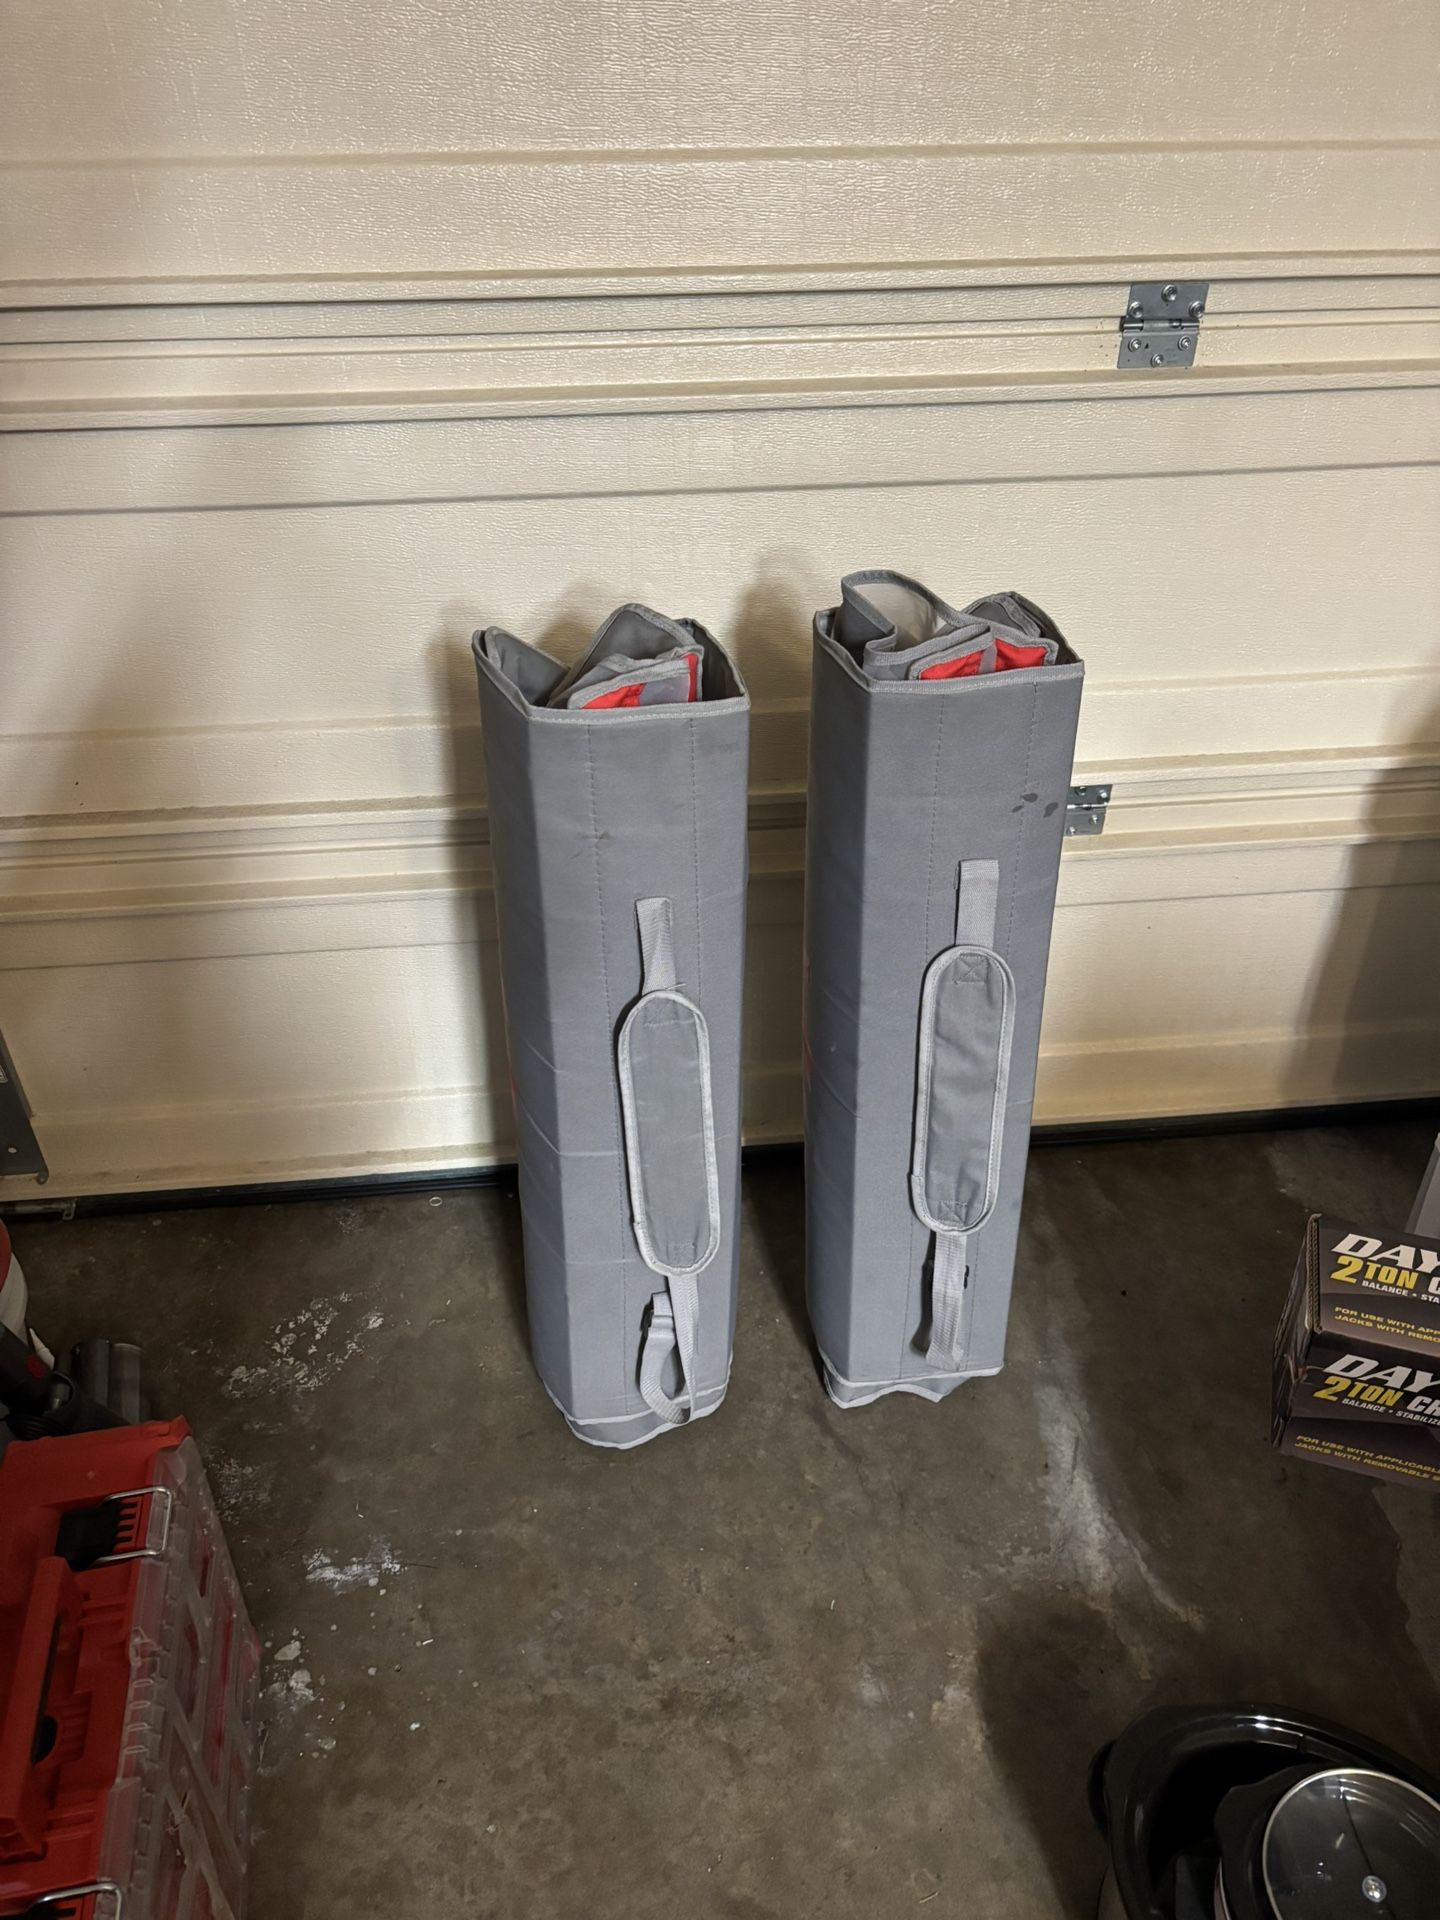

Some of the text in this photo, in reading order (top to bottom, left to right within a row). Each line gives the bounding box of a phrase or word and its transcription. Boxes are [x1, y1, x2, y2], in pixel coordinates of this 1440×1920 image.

[1331, 1233, 1440, 1274] DAY
[1362, 1280, 1409, 1297] BALANCE
[1334, 1306, 1358, 1317] FOR
[1360, 1312, 1384, 1323] USE
[1387, 1318, 1415, 1330] WITH
[1334, 1314, 1373, 1327] JACKS
[1376, 1323, 1405, 1335] WITH
[1322, 1353, 1440, 1393] DAY
[1342, 1398, 1386, 1413] BALANCE
[1296, 1435, 1319, 1444] FOR
[1321, 1440, 1345, 1451] USE
[1347, 1446, 1374, 1458] WITH
[1294, 1442, 1331, 1455] JACKS
[1334, 1450, 1361, 1463] WITH
[1363, 1458, 1430, 1479] REMOVABLE
